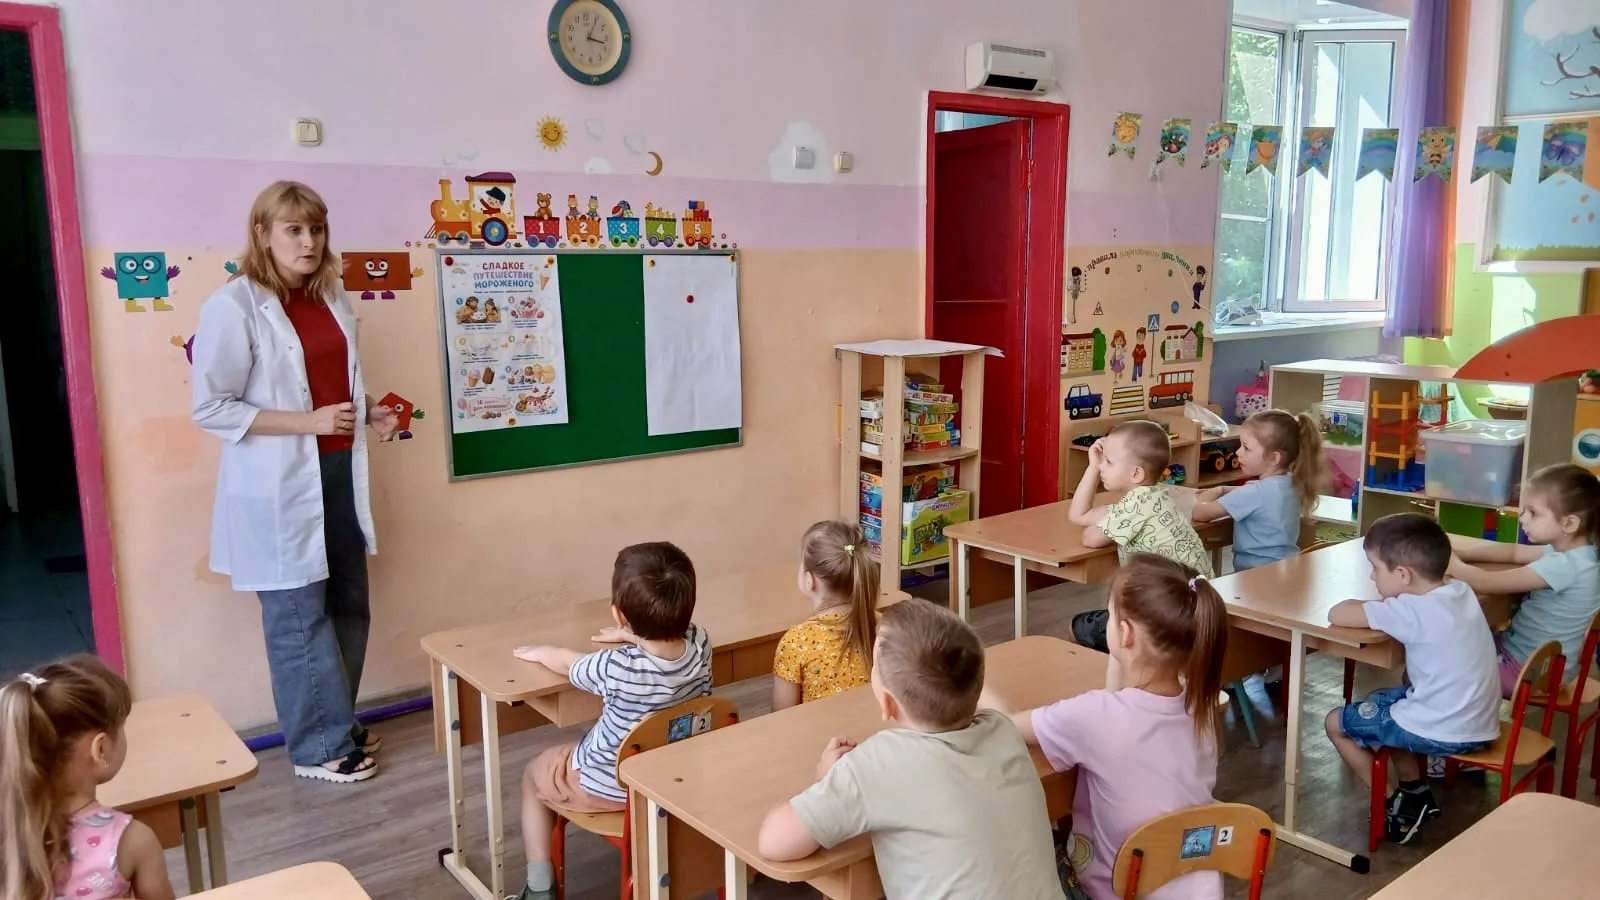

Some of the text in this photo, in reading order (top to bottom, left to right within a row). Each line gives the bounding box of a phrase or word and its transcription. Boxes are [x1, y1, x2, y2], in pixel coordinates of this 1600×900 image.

[538, 221, 545, 234] 1
[579, 222, 588, 234] 2
[619, 222, 628, 234] 3
[656, 223, 665, 235] 4
[694, 223, 702, 234] 5
[482, 261, 525, 270] СЛАДКОЕ
[473, 270, 534, 280] ПУТЕШЕСТВИЕ
[474, 279, 534, 289] МОРОЖЕНОГО
[699, 718, 706, 730] 2
[1220, 830, 1228, 842] 2
